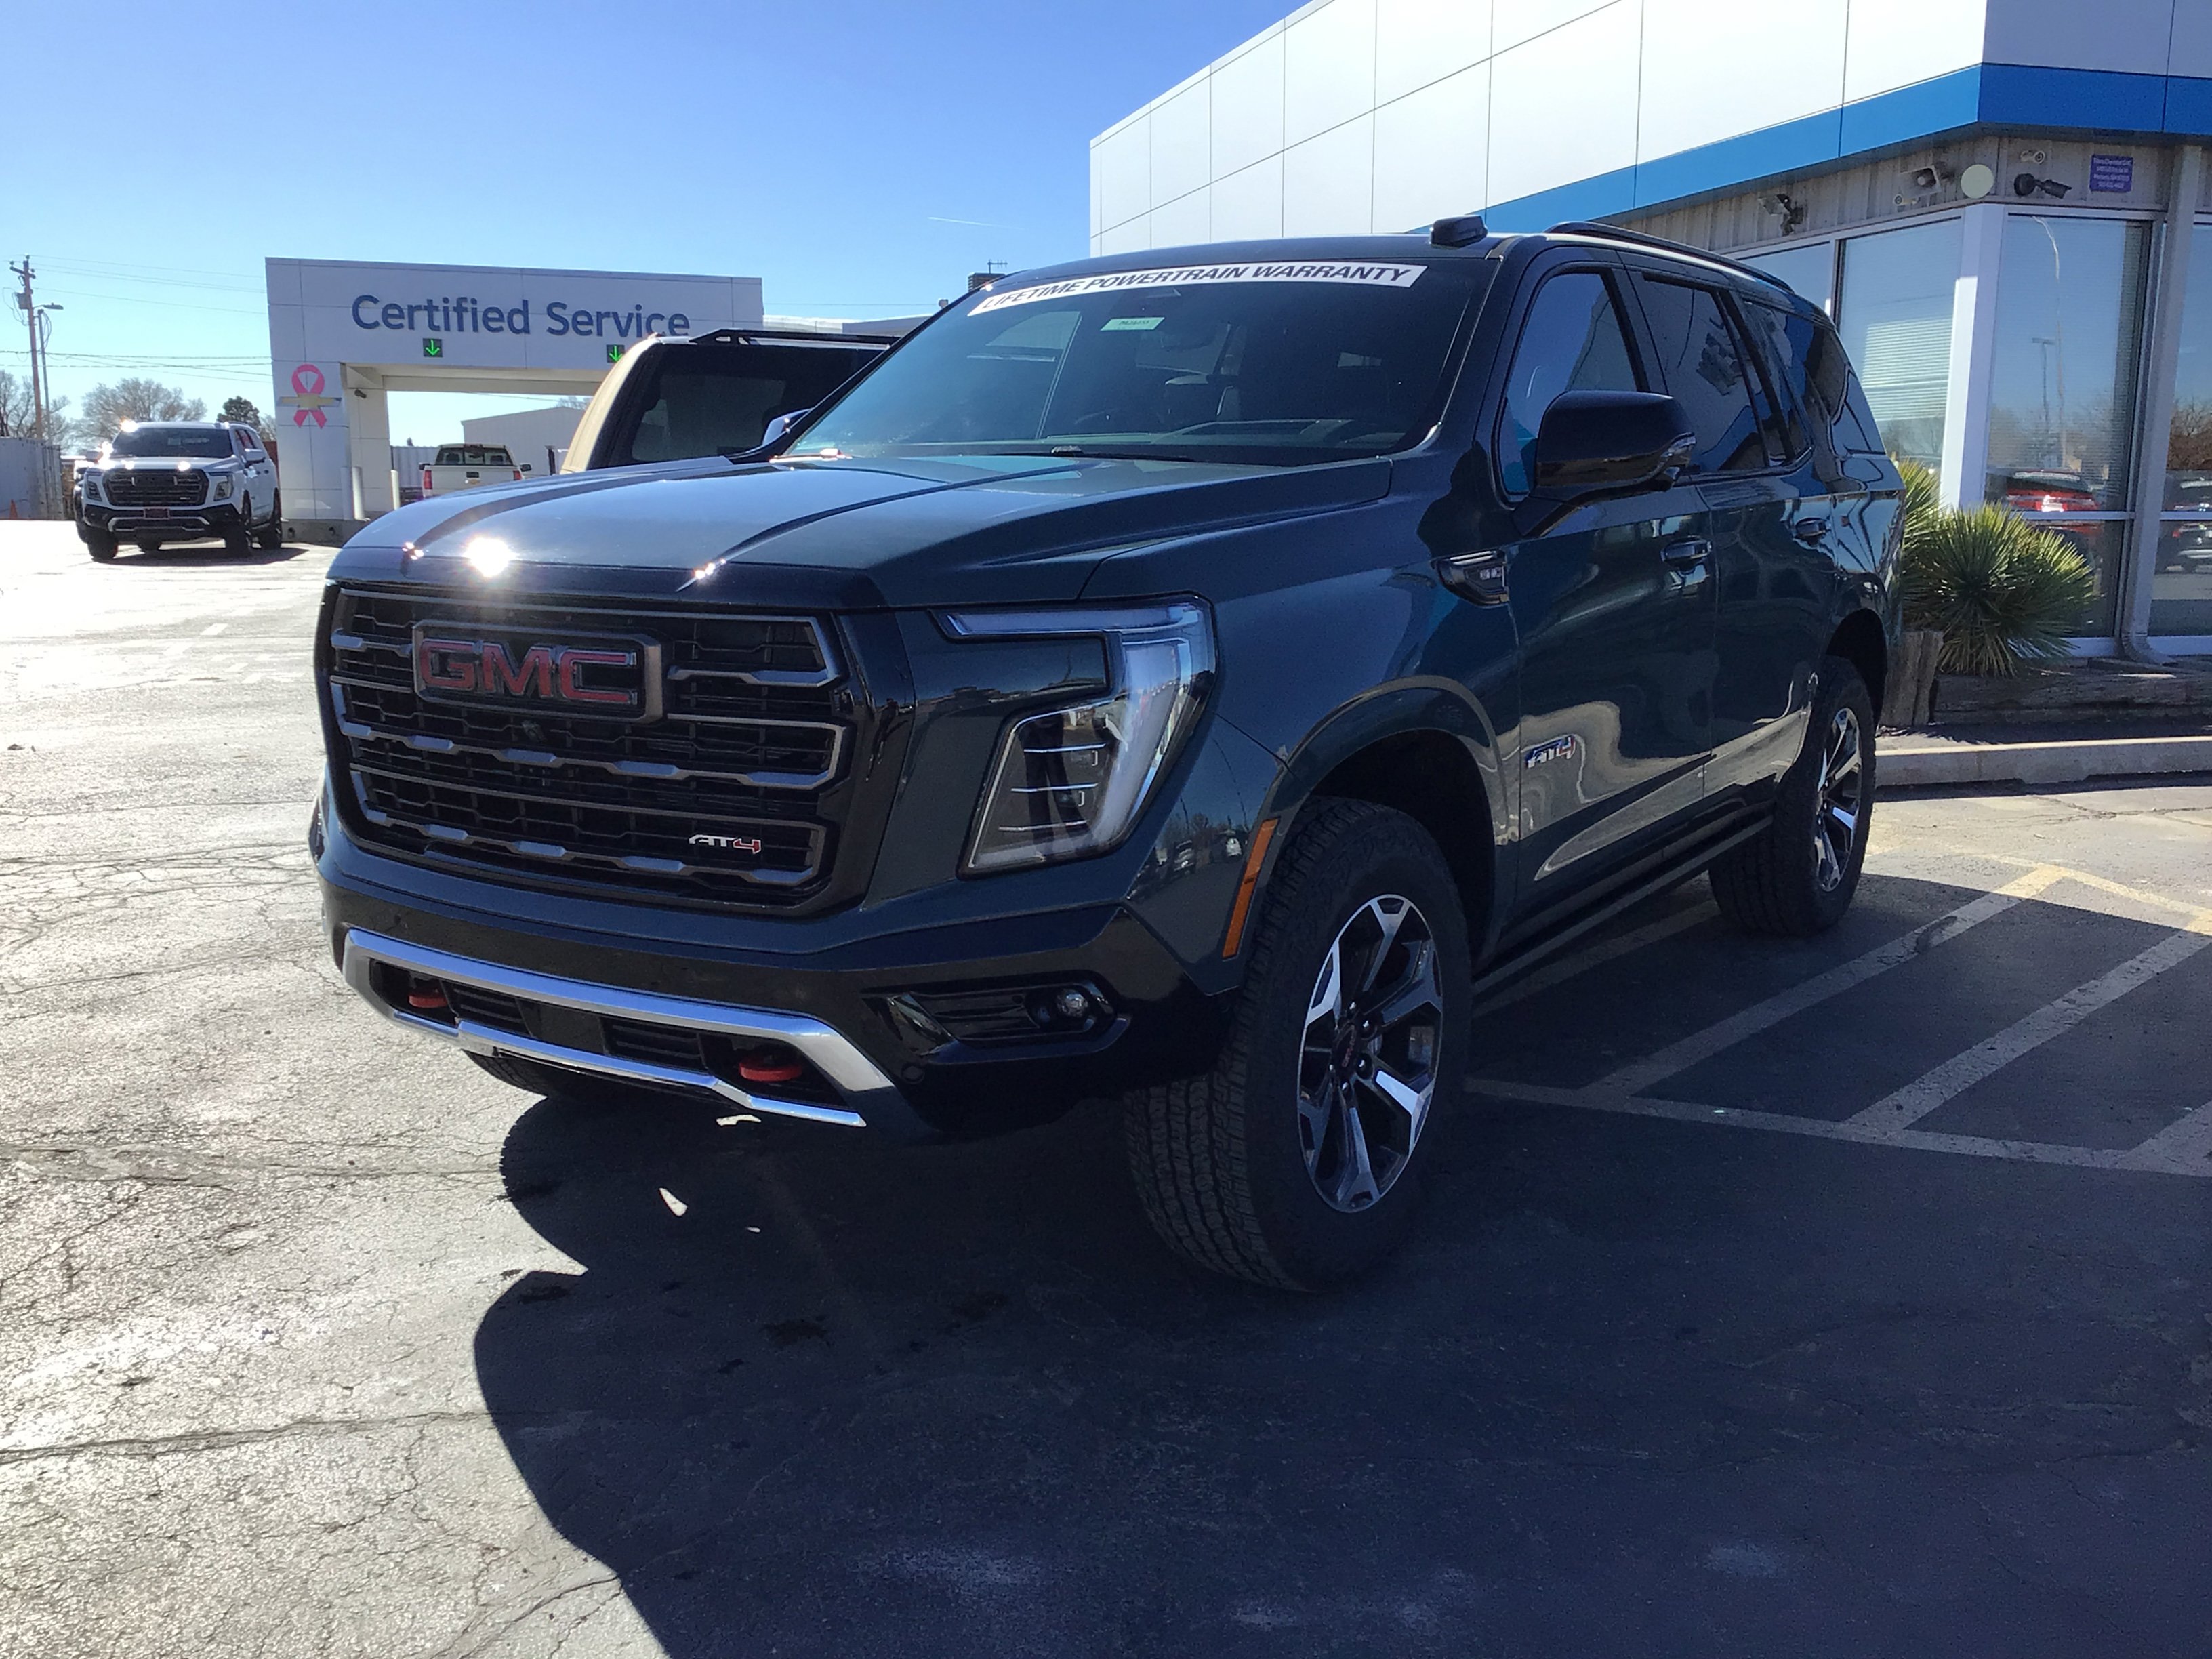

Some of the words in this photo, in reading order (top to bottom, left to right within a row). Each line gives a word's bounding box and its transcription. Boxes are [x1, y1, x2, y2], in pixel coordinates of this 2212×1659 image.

[981, 281, 1084, 309] LIFETIME
[1084, 266, 1249, 290] POWERTRAIN
[1252, 265, 1412, 281] WARRANTY
[352, 294, 531, 335] Certified
[546, 302, 690, 337] Service
[419, 637, 638, 705] GMC
[1525, 736, 1576, 769] AT4
[689, 834, 761, 854] AT4
